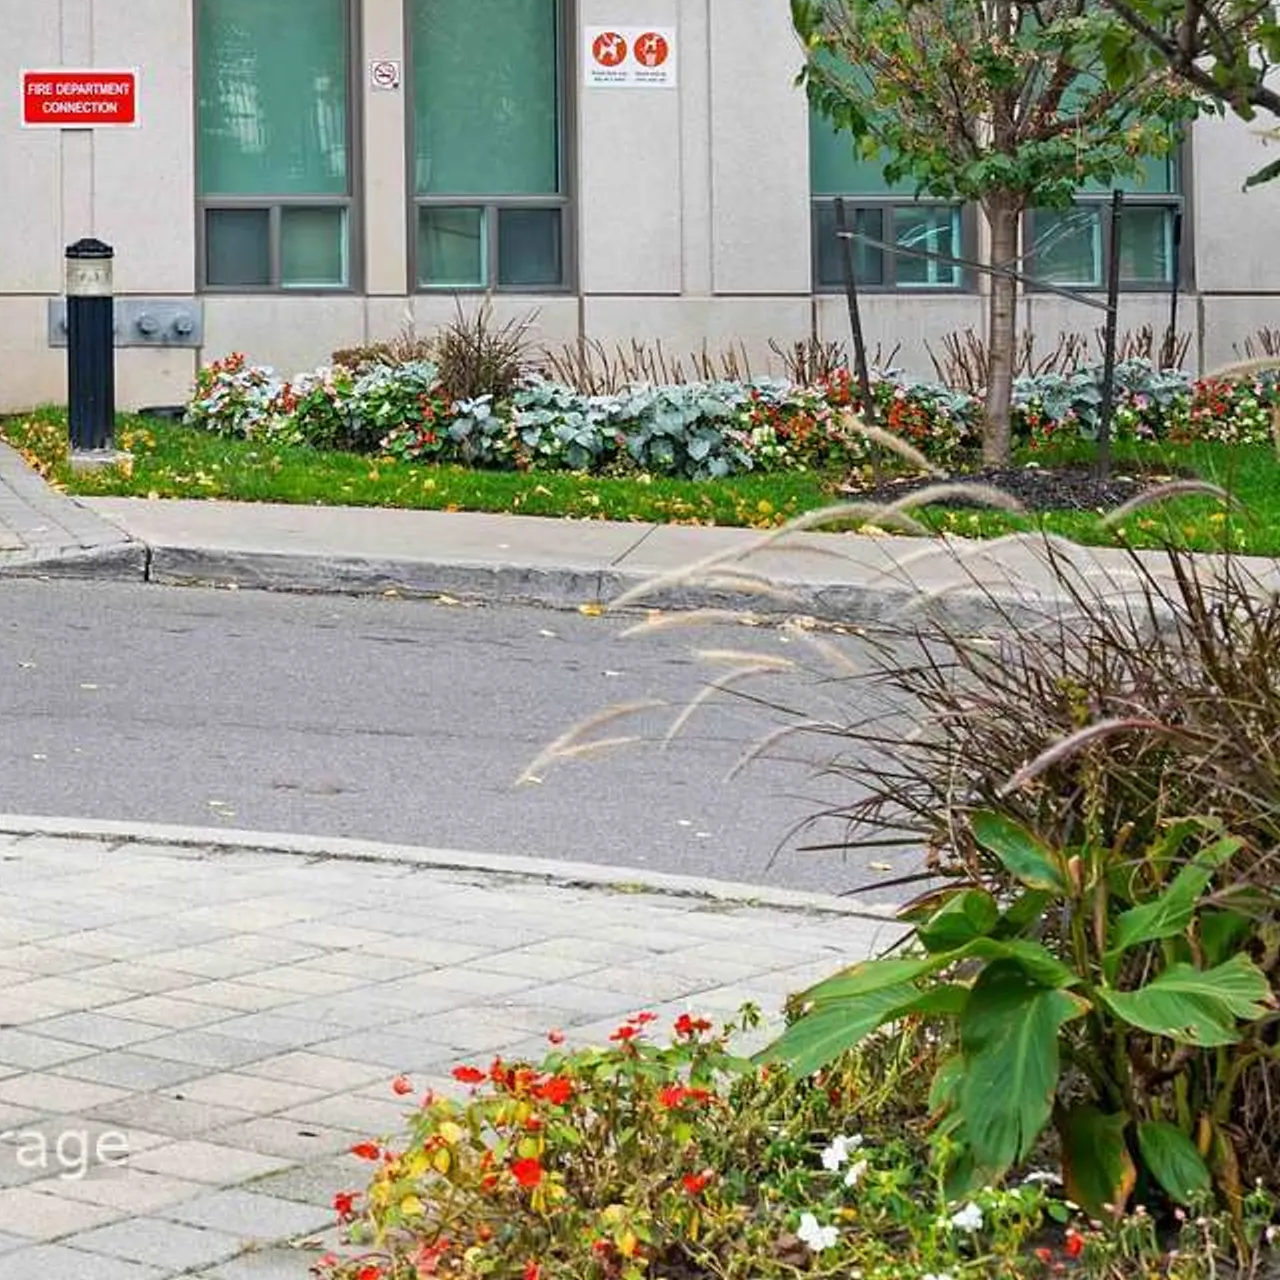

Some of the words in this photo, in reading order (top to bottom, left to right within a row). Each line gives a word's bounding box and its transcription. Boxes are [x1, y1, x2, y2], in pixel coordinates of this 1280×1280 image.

[28, 83, 52, 95] FIRE
[56, 83, 129, 95] DEPARTMENT
[43, 102, 117, 113] CONNECTION
